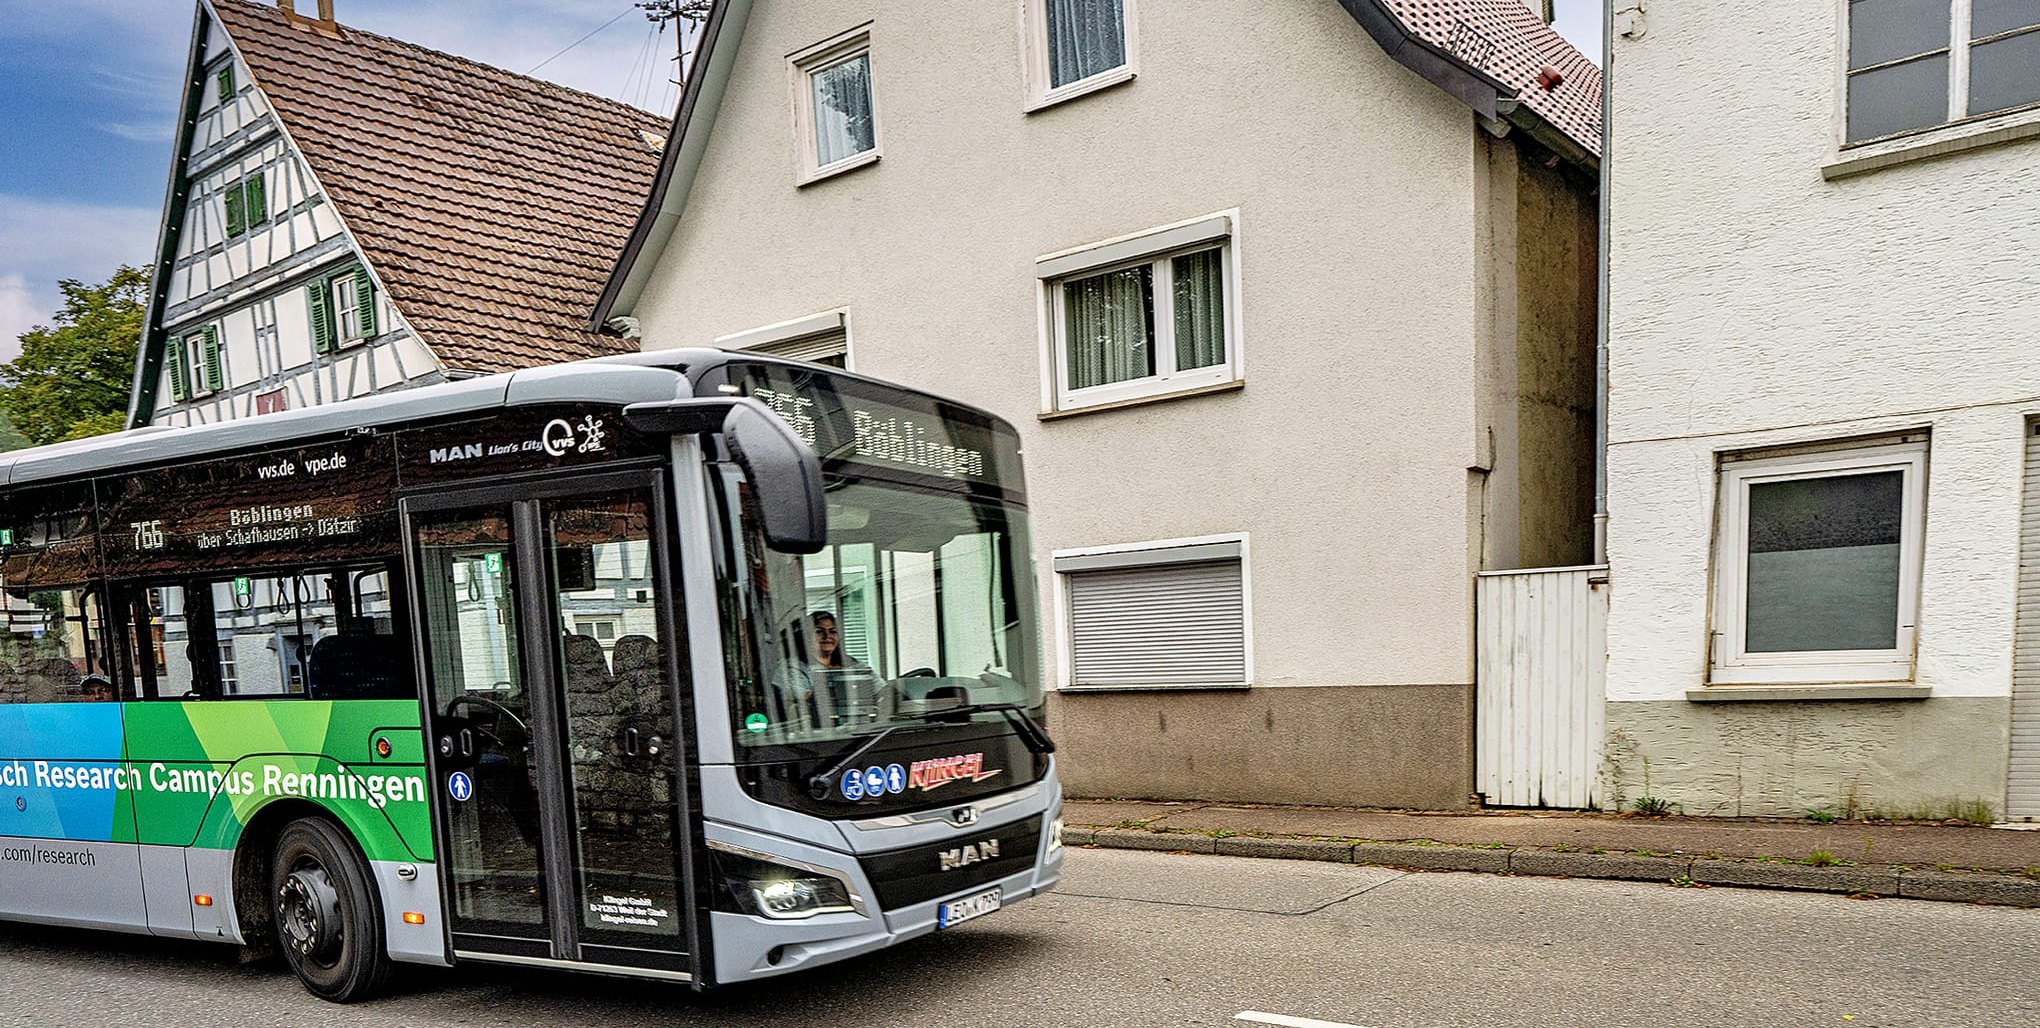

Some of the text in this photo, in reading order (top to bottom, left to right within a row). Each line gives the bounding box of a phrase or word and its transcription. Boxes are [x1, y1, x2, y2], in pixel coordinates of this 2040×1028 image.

[429, 439, 543, 464] MAN Lion's City
[552, 437, 576, 449] vvs
[854, 410, 983, 477] Böblingen
[257, 453, 347, 480] vvs.de vpe.de
[230, 504, 313, 526] Böblingen
[130, 519, 163, 551] 766
[197, 532, 222, 549] über
[225, 525, 299, 546] Schafhausen
[33, 760, 143, 791] Research
[149, 762, 255, 800] Campus
[263, 764, 425, 808] Renningen
[939, 839, 1000, 871] MAN
